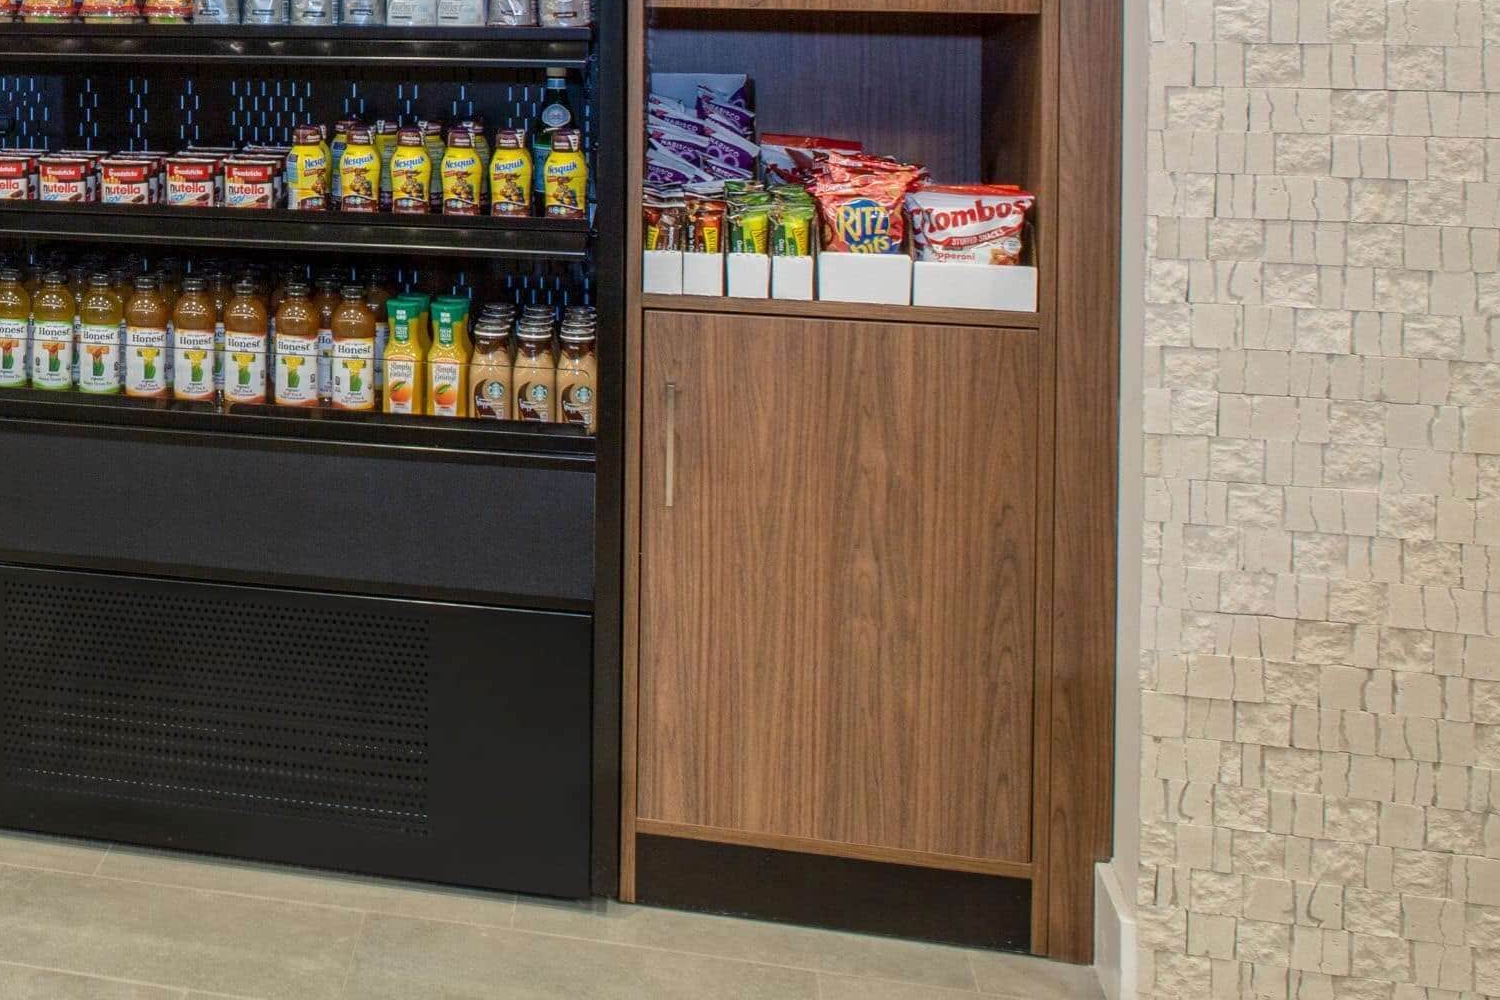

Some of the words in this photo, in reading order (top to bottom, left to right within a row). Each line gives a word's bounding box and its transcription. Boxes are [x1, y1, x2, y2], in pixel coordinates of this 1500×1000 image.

[43, 182, 78, 193] nutella
[105, 183, 141, 194] nutella
[170, 182, 206, 193] nutella
[228, 184, 265, 194] nutella
[837, 206, 890, 242] RITZ
